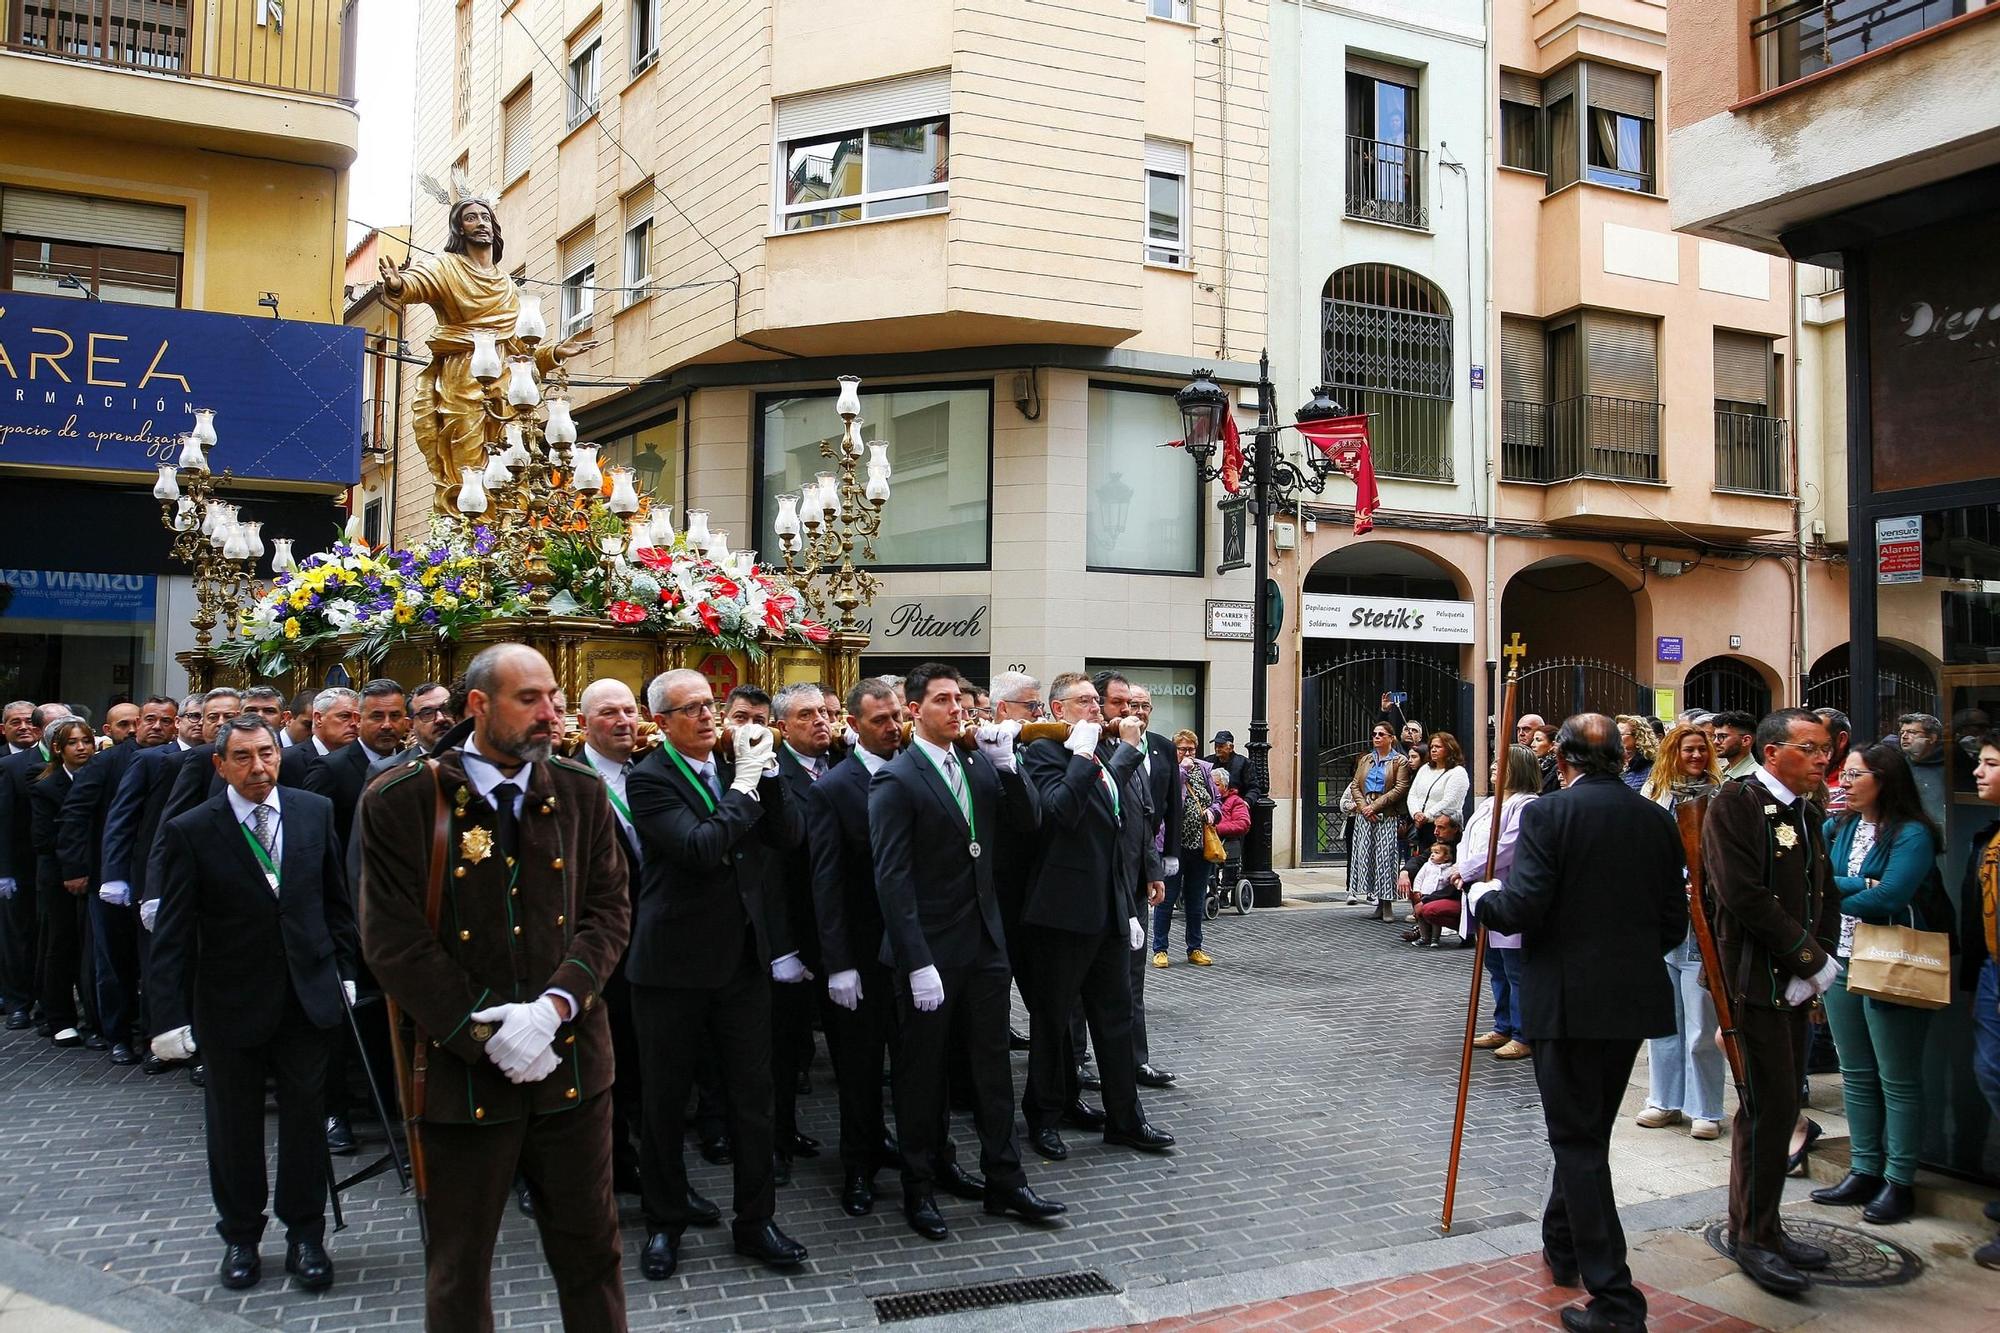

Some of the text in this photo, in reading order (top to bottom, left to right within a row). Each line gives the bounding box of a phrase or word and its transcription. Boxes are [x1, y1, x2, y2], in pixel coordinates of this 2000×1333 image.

[16, 388, 192, 414] RMACIÓN
[0, 414, 186, 461] pacio de aprendizaje
[1881, 545, 1919, 554] Alarma
[885, 603, 987, 637] Pitarch
[1305, 604, 1341, 613] Depilaciones
[1349, 607, 1424, 630] Stetik's
[1142, 683, 1196, 696] ERSARIO
